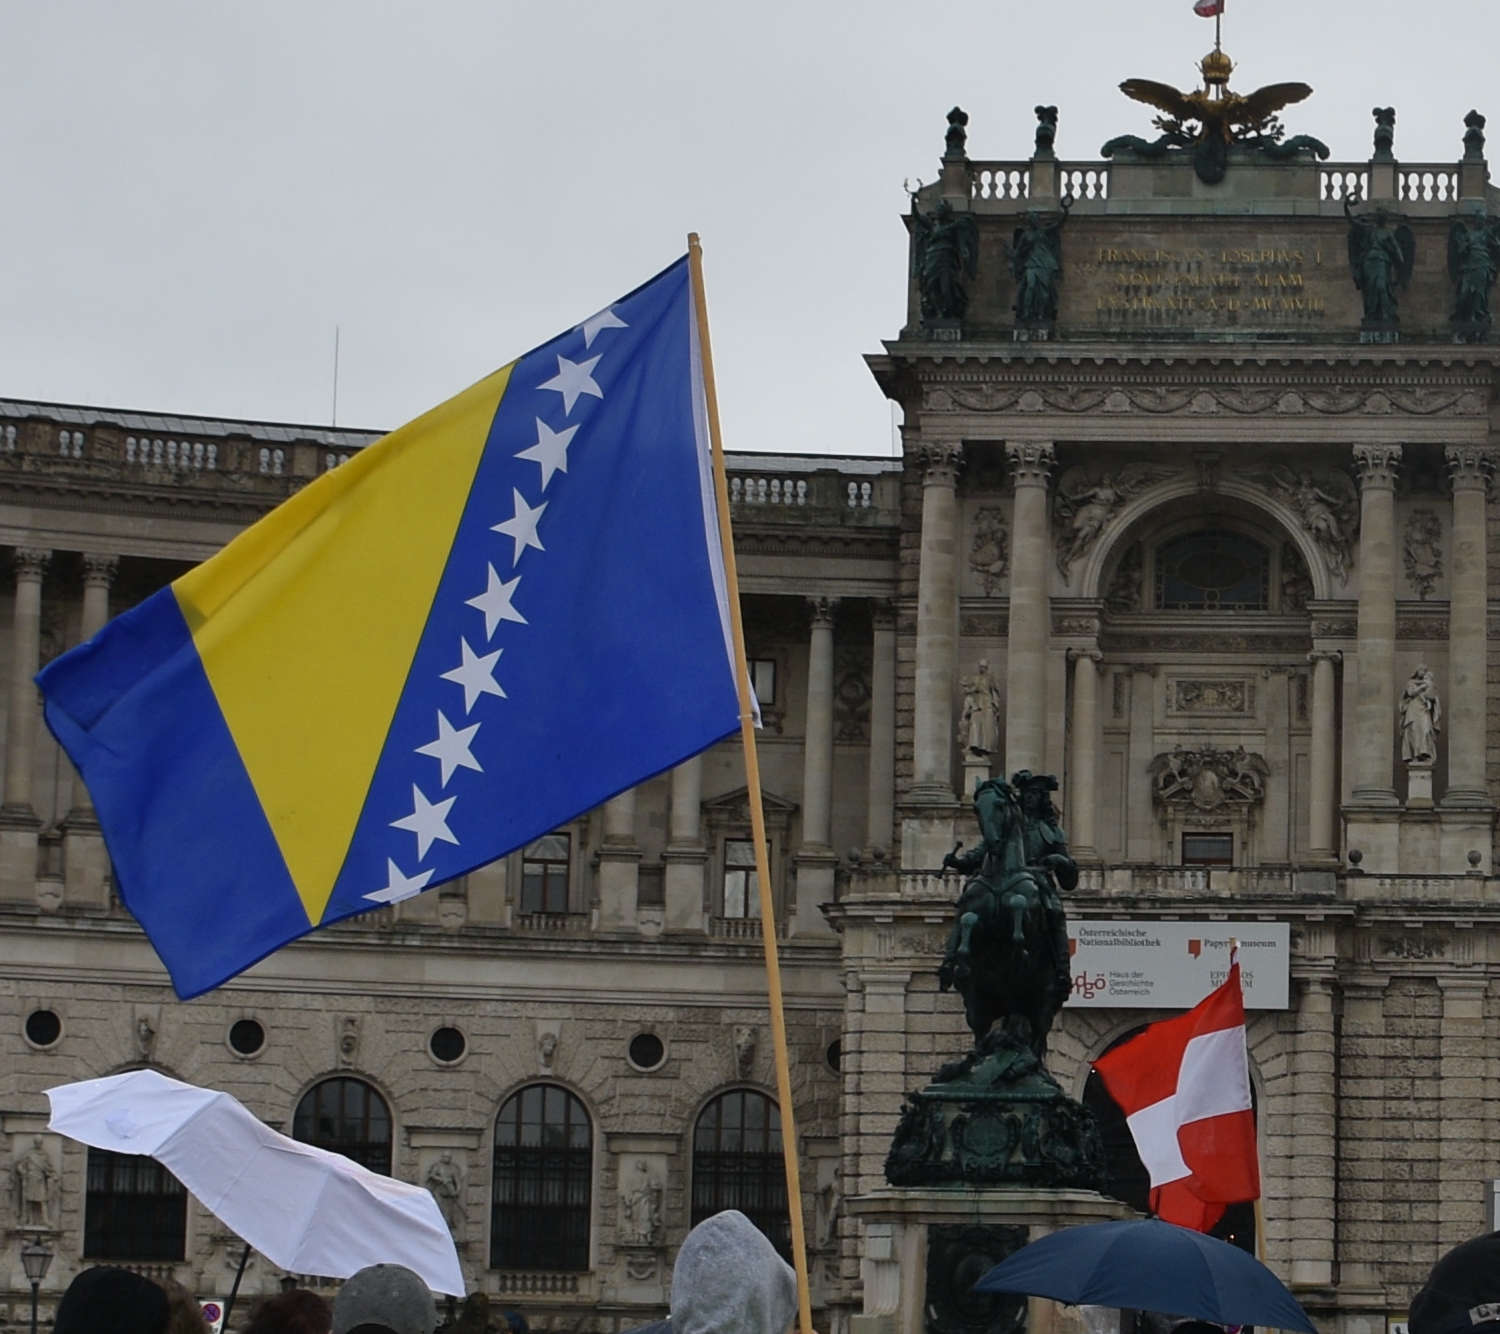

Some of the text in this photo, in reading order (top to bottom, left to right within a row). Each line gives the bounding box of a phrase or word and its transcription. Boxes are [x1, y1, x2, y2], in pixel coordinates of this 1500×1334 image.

[1079, 927, 1147, 938] Österreichische
[1079, 938, 1161, 947] Nationalbibliothek
[1204, 939, 1277, 950] Papyrmuseum
[1109, 979, 1154, 988] Geschichte
[1109, 987, 1151, 996] Österreich
